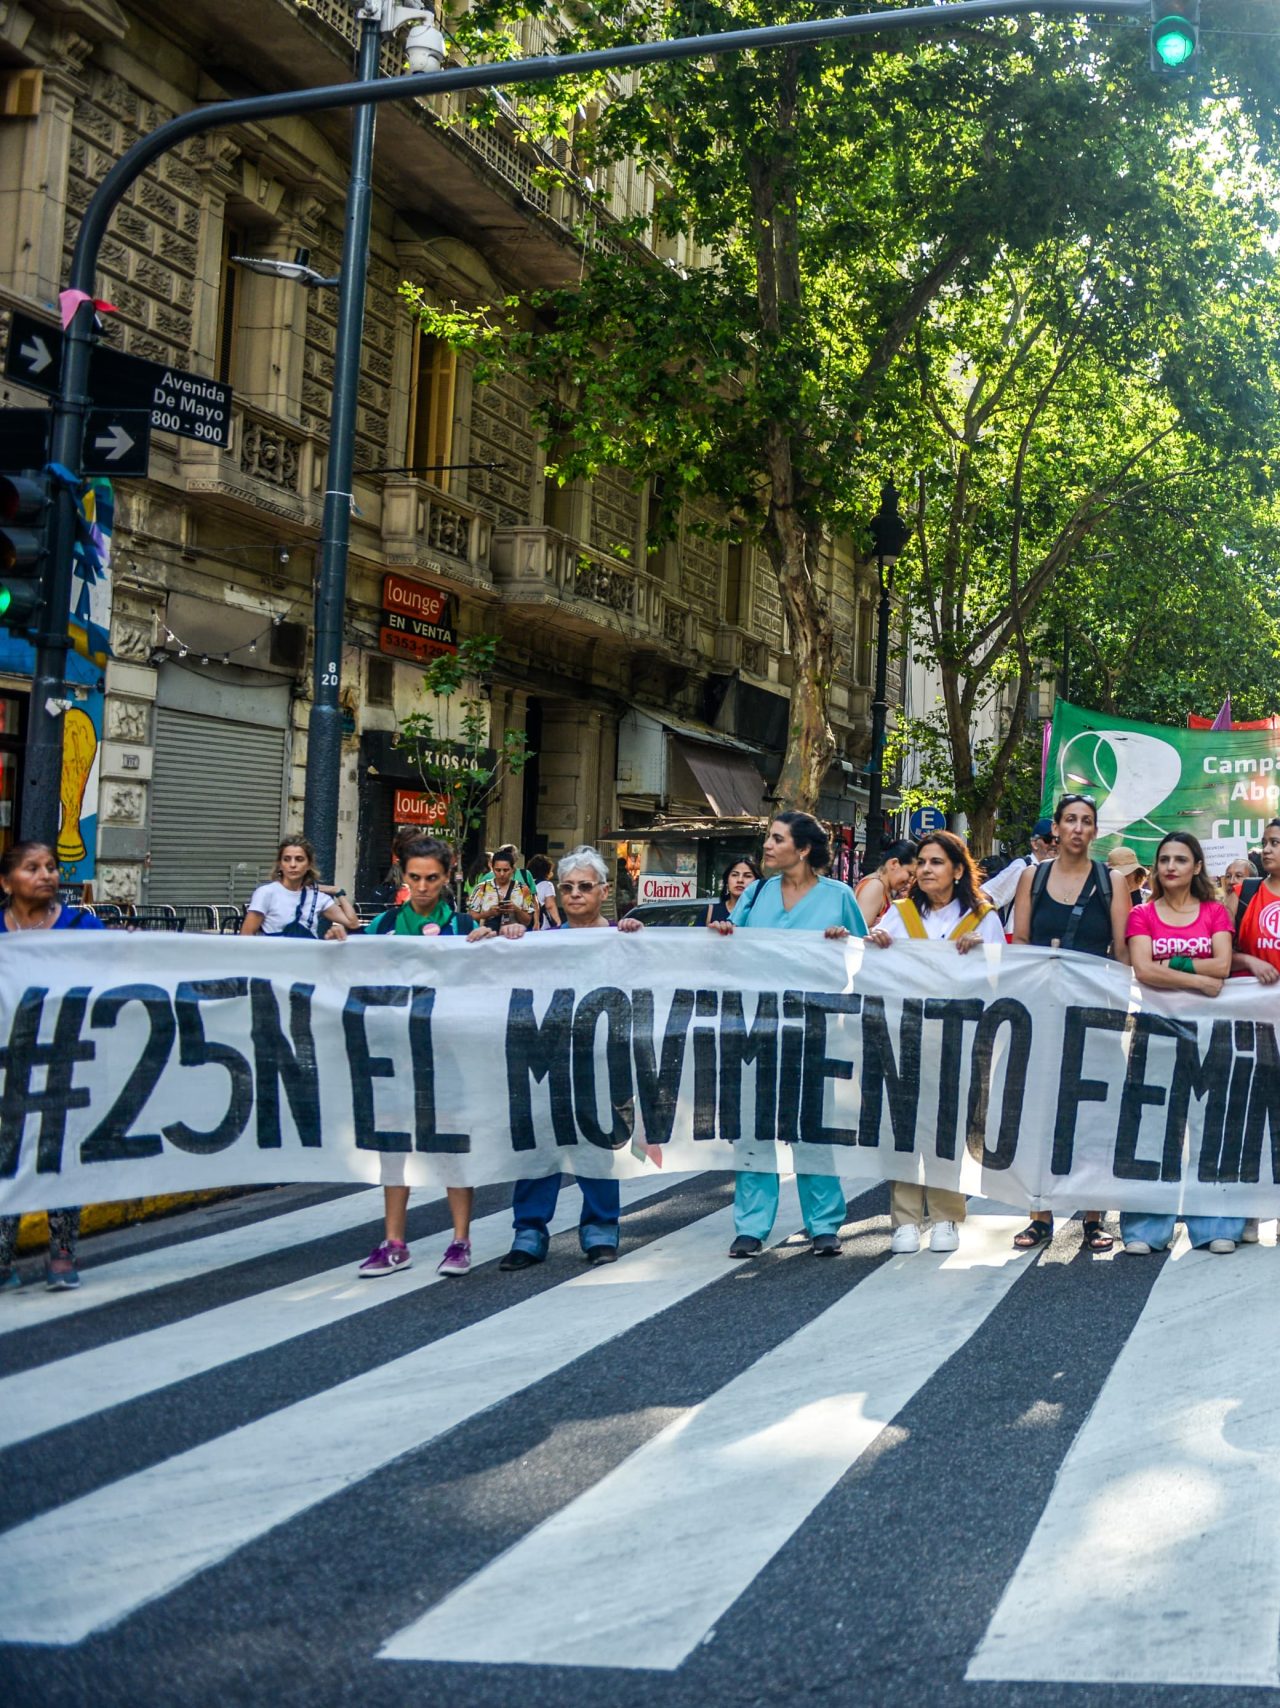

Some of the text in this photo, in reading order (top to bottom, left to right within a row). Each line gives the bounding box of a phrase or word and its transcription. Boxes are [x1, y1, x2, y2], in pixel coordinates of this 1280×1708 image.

[161, 371, 225, 403] Avenida
[153, 387, 224, 422] De Mayo
[151, 410, 181, 431] 800
[194, 422, 223, 442] 900
[387, 579, 440, 616] lounge
[388, 614, 452, 643] EN VENTA
[321, 673, 338, 686] 20
[328, 661, 337, 674] 8
[921, 810, 935, 829] E
[0, 976, 323, 1180] #25N
[343, 984, 471, 1154] EL
